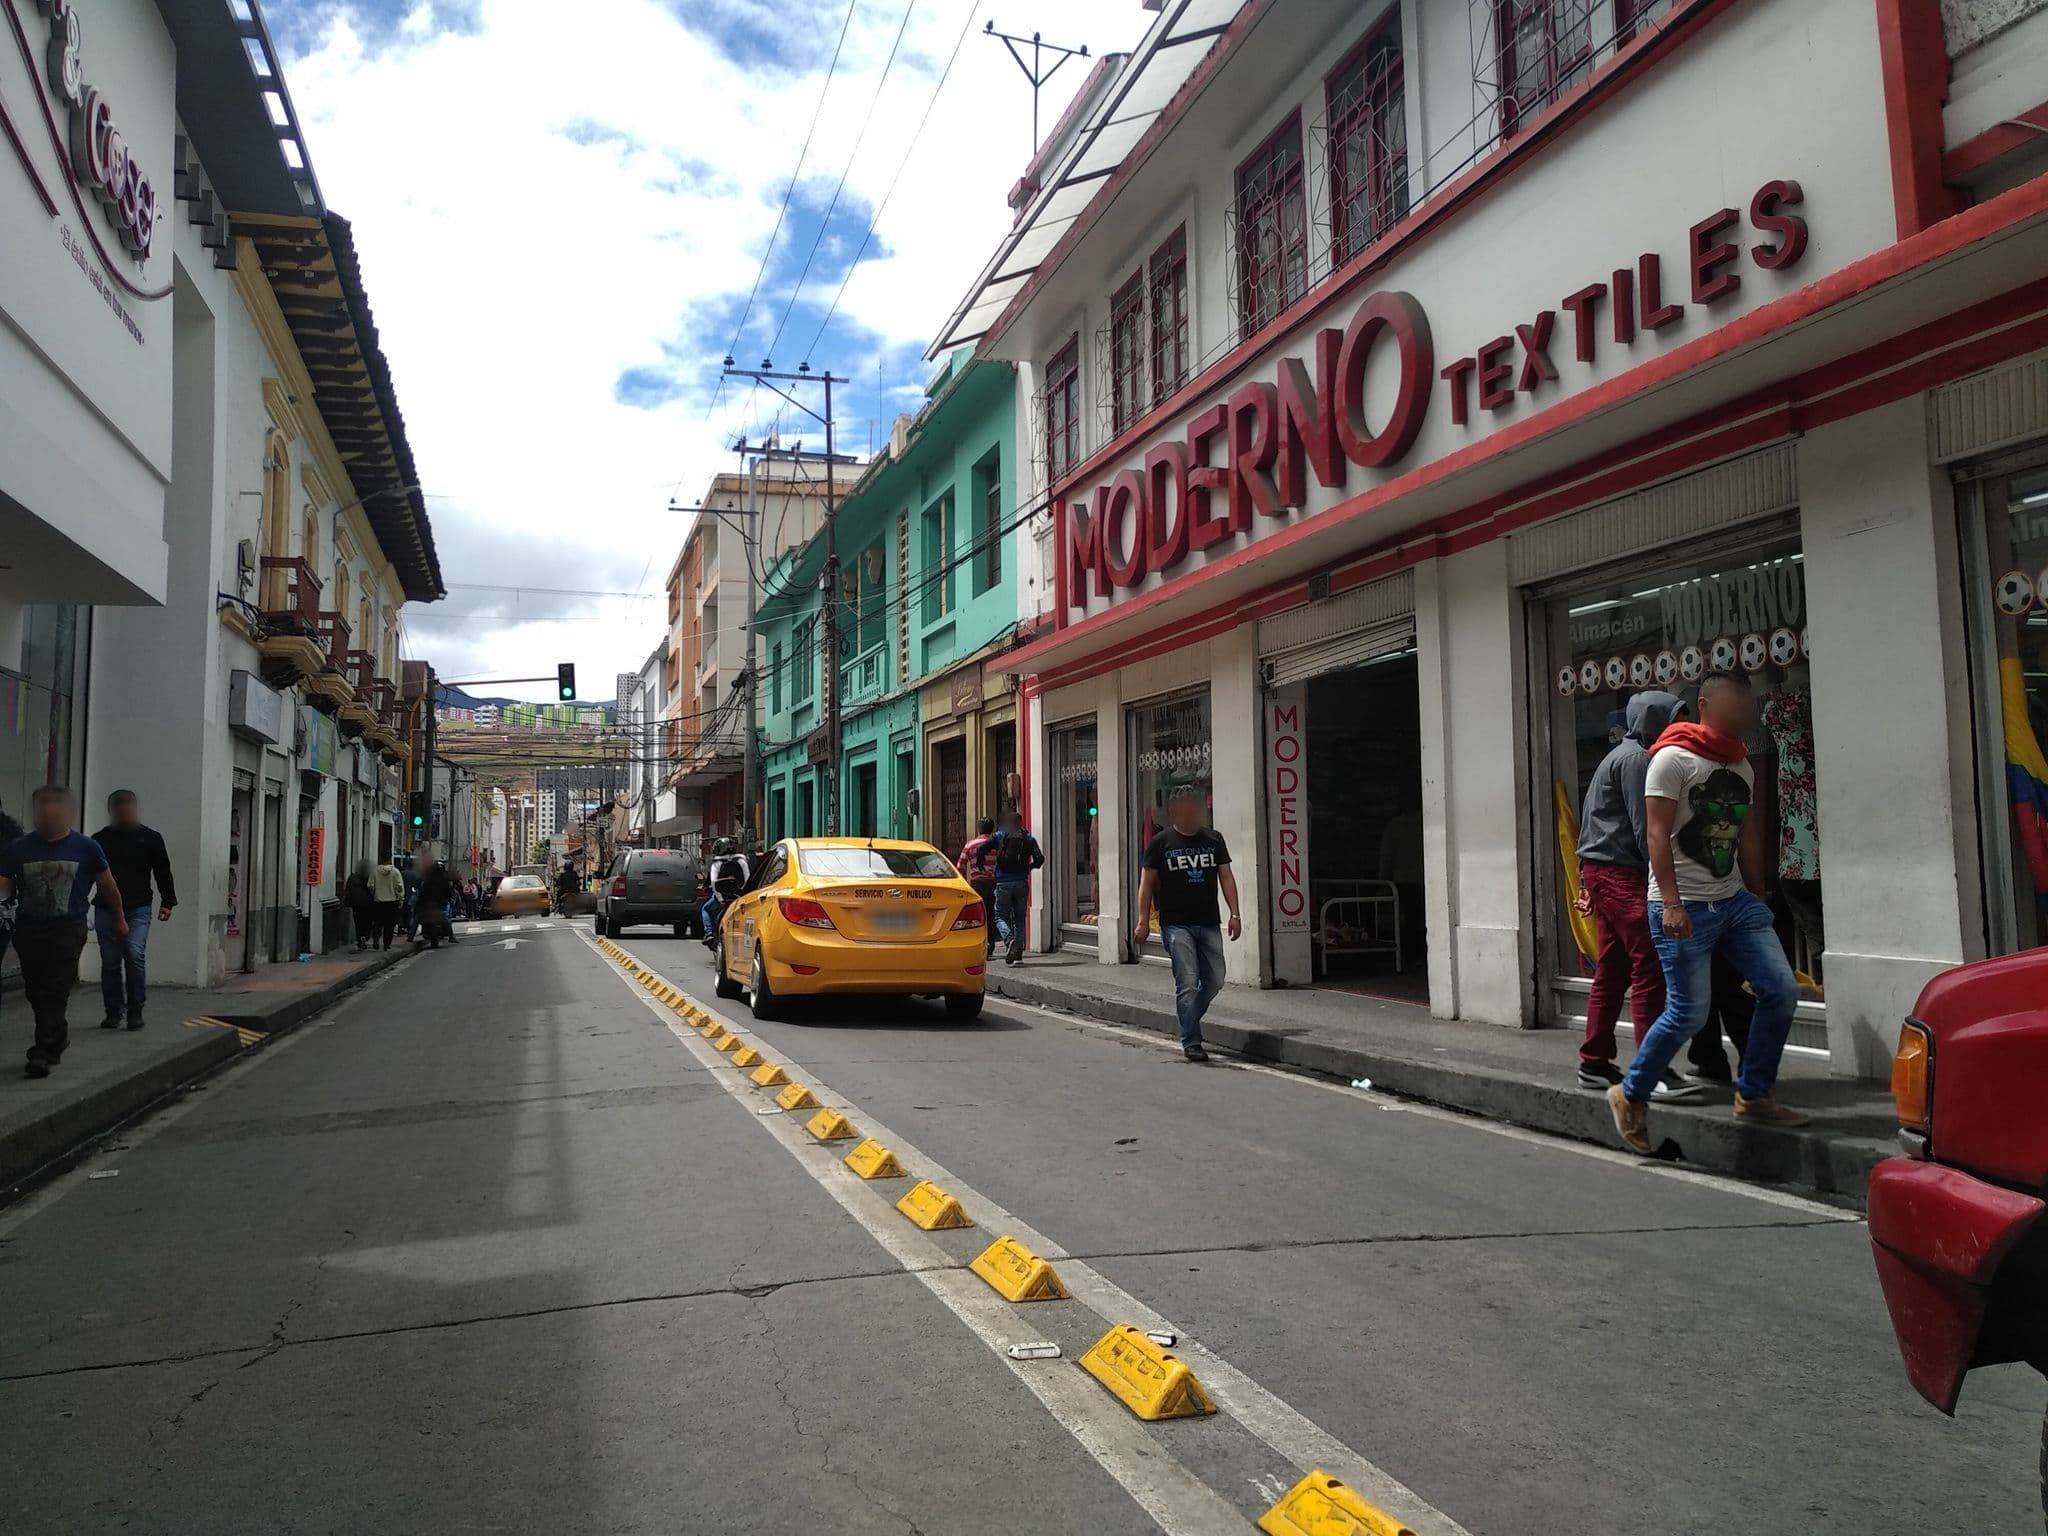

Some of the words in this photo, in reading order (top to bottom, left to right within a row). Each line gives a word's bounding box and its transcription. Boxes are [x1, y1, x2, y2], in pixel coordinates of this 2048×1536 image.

[1440, 179, 1808, 425] TEXTILES
[1069, 291, 1434, 609] MODERNO
[1568, 613, 1645, 642] Almacén
[1659, 555, 1800, 648] MODERNO
[1273, 704, 1305, 916] MODERNO
[308, 830, 321, 883] RECARGAS
[1165, 848, 1183, 858] GET
[1185, 847, 1200, 855] ON
[1167, 853, 1217, 871] LEVEL
[855, 889, 883, 898] SERVICIO
[906, 889, 932, 899] PUBLICO
